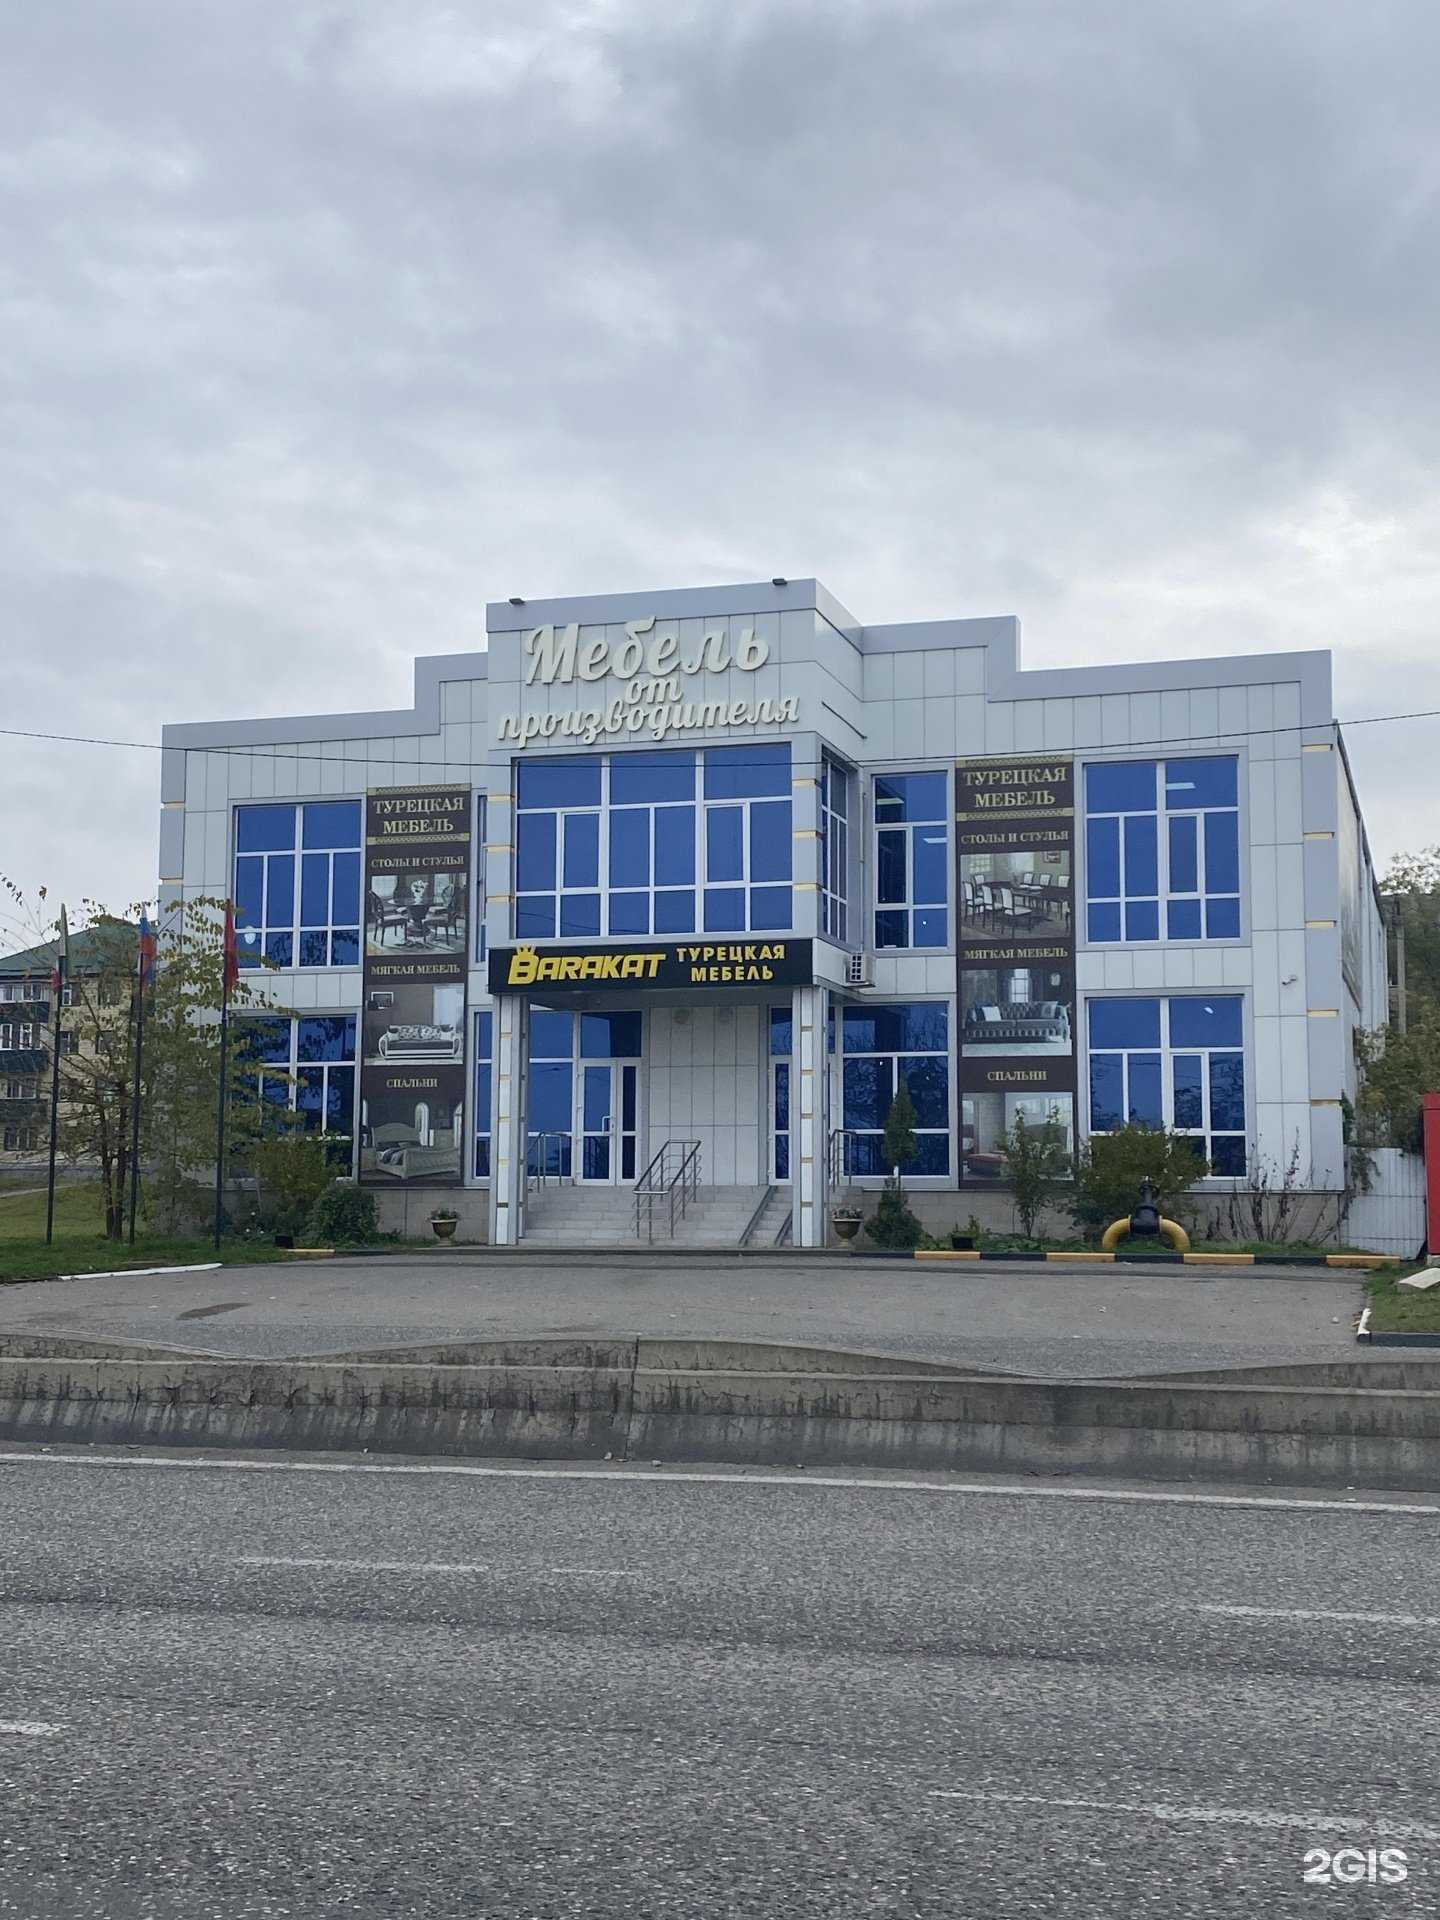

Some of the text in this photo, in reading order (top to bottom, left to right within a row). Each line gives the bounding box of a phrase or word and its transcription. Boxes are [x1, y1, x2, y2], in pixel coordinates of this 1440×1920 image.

[525, 615, 770, 686] Мебель
[624, 677, 684, 705] от
[497, 696, 801, 750] производителя
[962, 767, 1068, 787] ТУРЕЦКАЯ
[374, 797, 464, 815] ТУРЕЦКАЯ
[974, 790, 1056, 808] МЕБЕЛЬ
[383, 818, 454, 835] МЕБЕЛЬ
[961, 830, 1069, 844] СТОЛЫ И СТУЛЬЯ
[371, 856, 464, 868] СТОЛЫ И СТУЛЬЯ
[676, 944, 786, 962] ТУРЕЦКАЯ
[964, 947, 1068, 960] МЯГКАЯ МЕБЕЛЬ
[370, 964, 460, 976] МЯГКАЯ МЕБЕЛЬ
[507, 952, 667, 985] BARAKAT
[691, 965, 774, 982] МЕБЕЛЬ
[386, 1078, 438, 1089] СПАЛЬНИ
[987, 1070, 1047, 1081] СПАЛЬНИ
